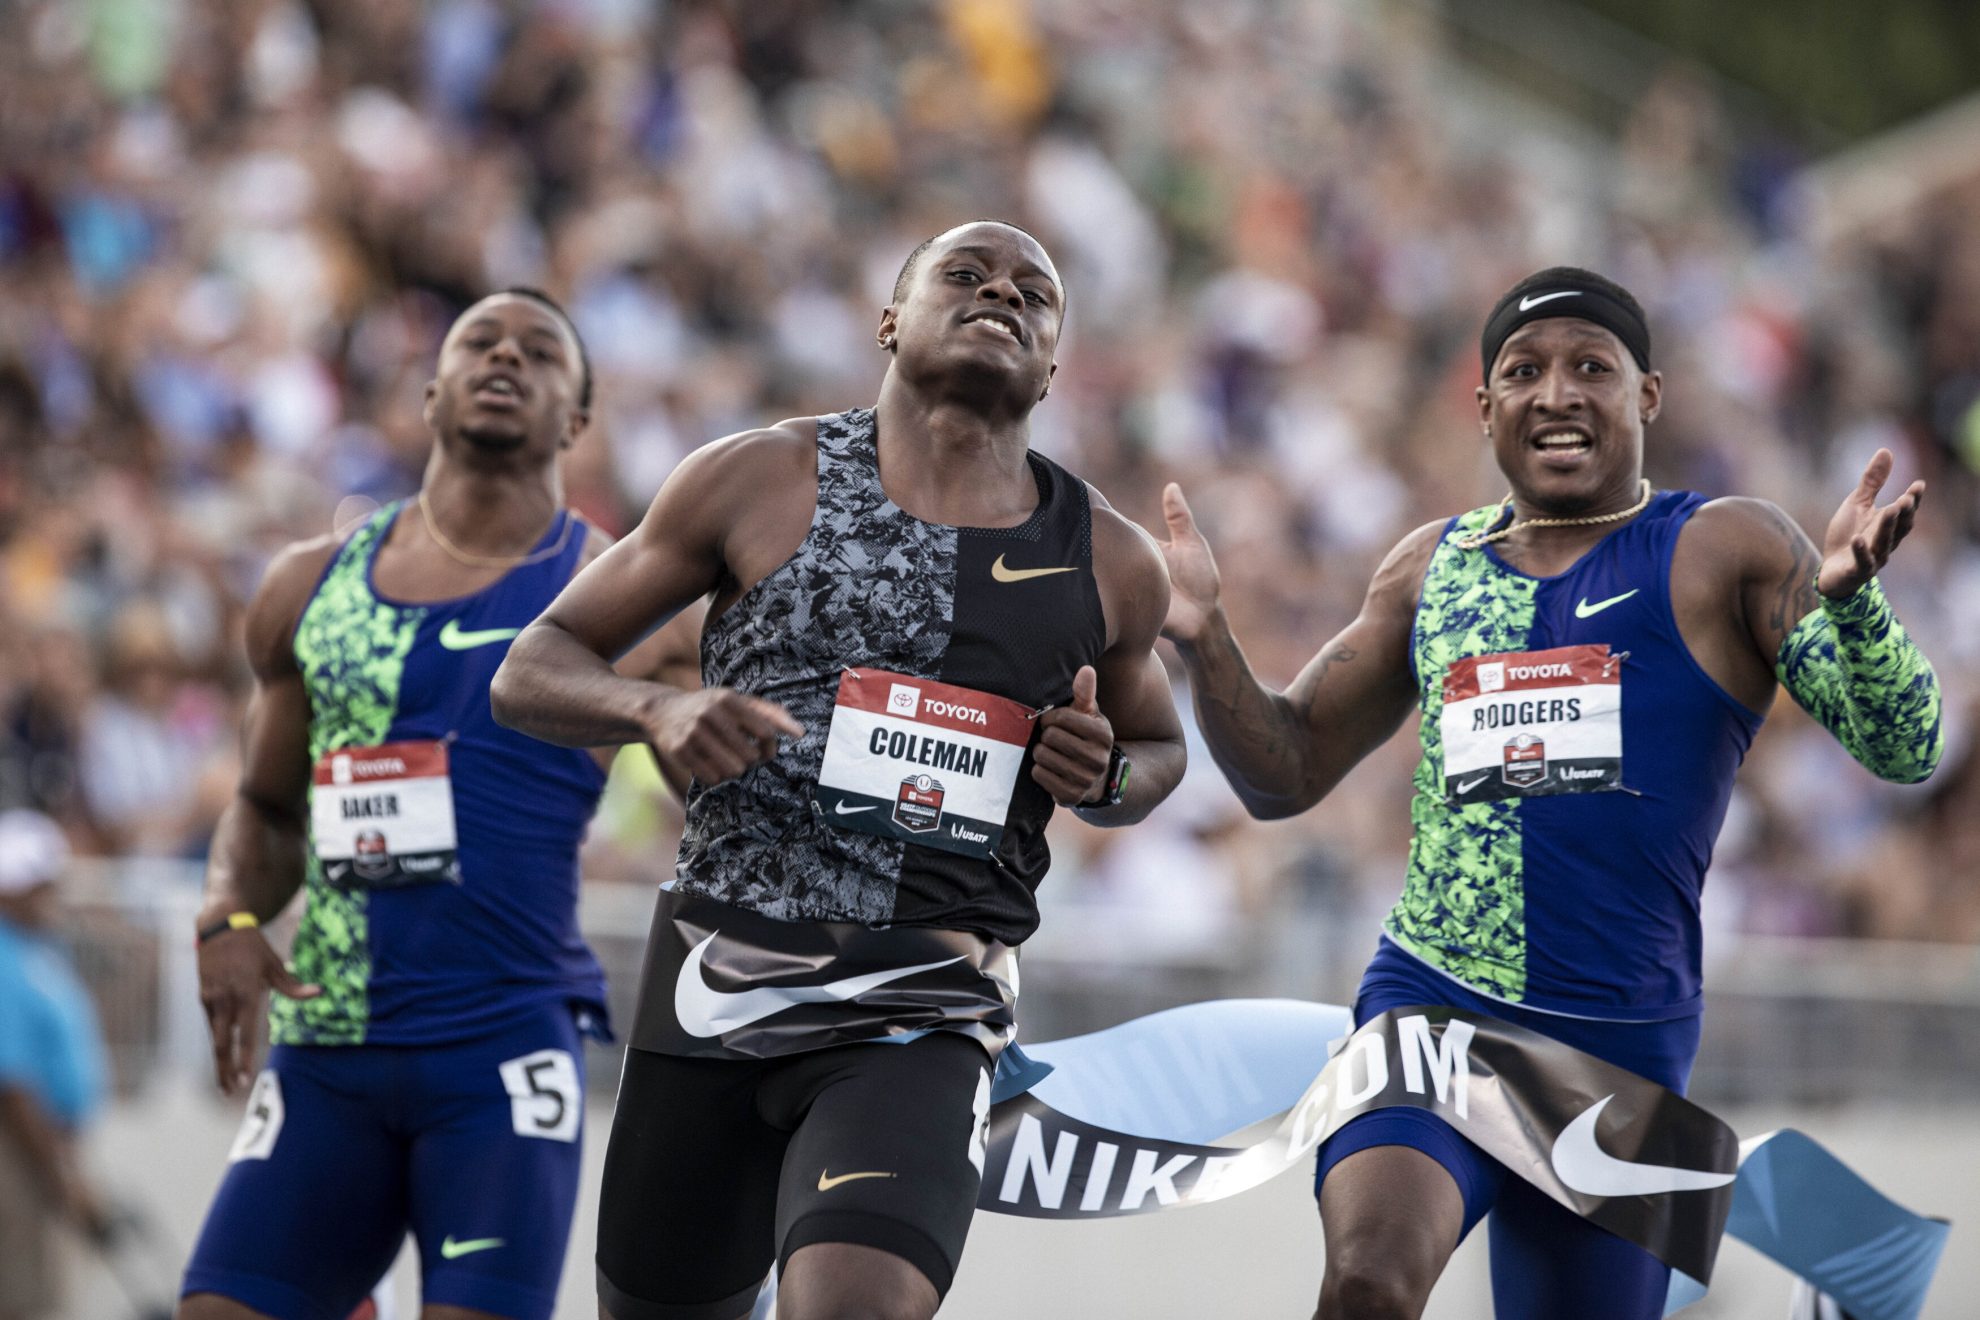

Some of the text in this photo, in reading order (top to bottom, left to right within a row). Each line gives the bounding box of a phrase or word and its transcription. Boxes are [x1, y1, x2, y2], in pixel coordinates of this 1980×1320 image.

[1507, 663, 1573, 681] TOYOTA
[924, 698, 987, 726] TOYOTA
[1472, 698, 1581, 731] RODGERS
[352, 757, 406, 776] TOYOTA
[869, 727, 988, 778] COLEMAN
[962, 831, 989, 843] USATF
[525, 1060, 564, 1129] 5
